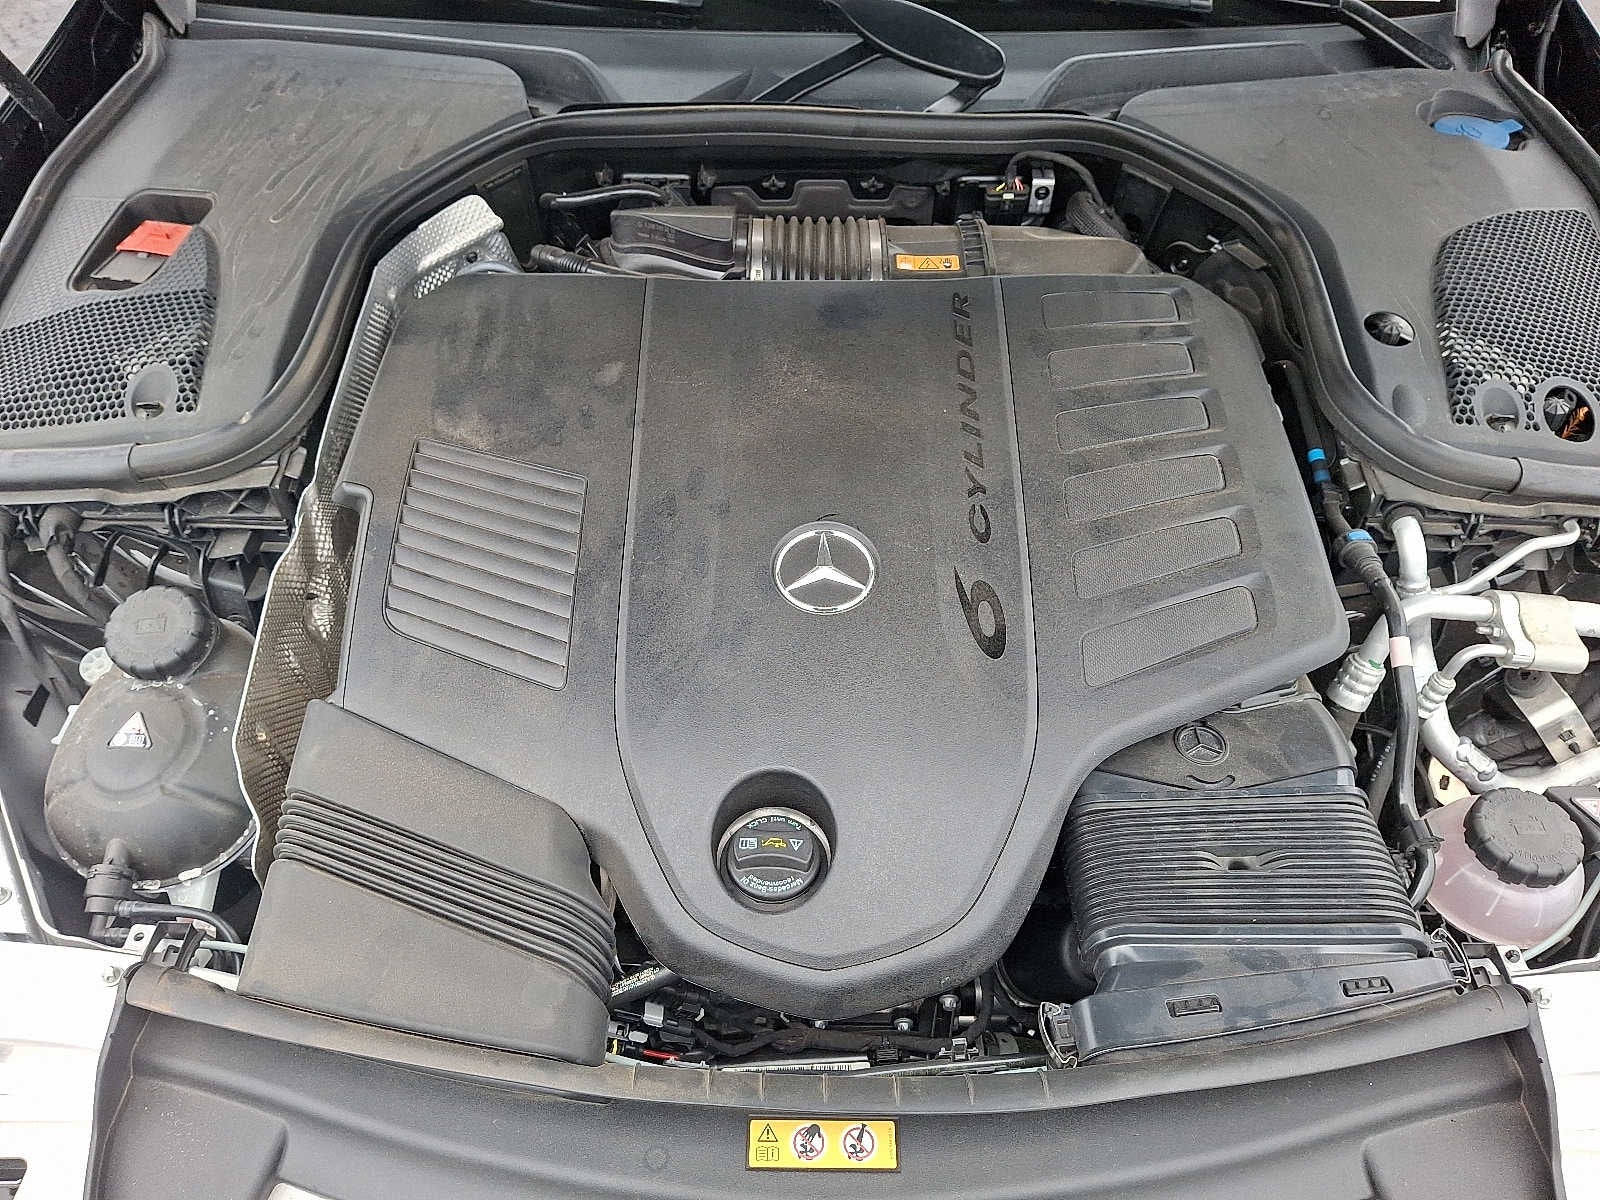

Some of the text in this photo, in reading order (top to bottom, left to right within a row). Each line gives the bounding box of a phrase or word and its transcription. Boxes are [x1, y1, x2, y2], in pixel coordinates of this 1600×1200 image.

[952, 291, 1007, 660] 6 CYLINDER
[747, 817, 768, 829] CLICK
[748, 874, 795, 887] recommended
[750, 877, 804, 893] Mercedes-Benz
